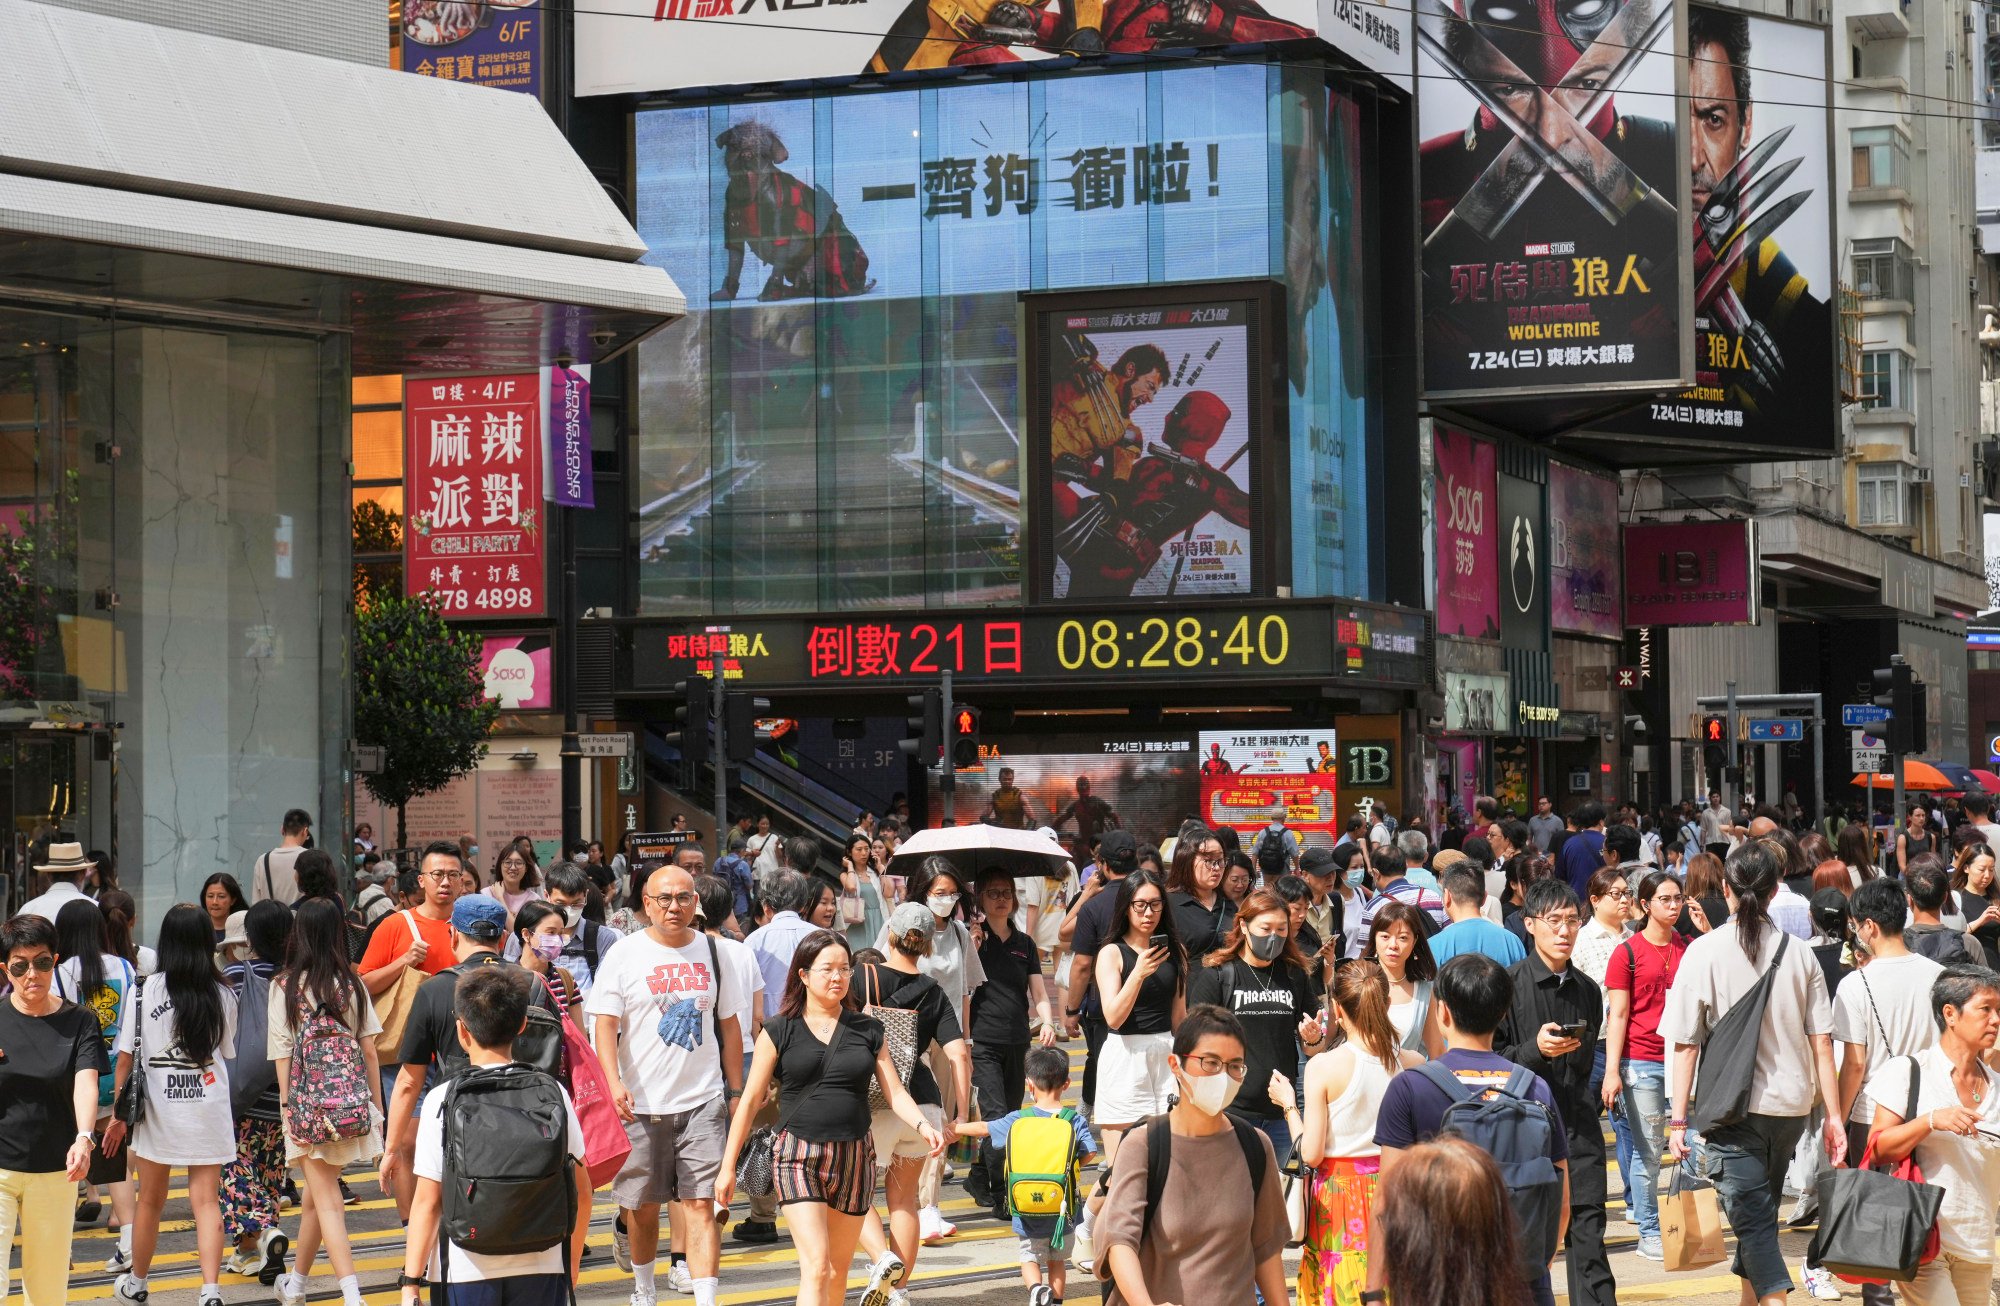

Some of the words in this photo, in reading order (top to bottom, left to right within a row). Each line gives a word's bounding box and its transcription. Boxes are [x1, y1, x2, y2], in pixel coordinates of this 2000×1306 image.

[499, 21, 532, 43] 6/F
[478, 62, 531, 77] 韓國料理
[1525, 244, 1549, 256] MARVEL
[1550, 241, 1575, 254] STUDIOS
[1450, 254, 1651, 304] 死侍與狼人
[1507, 303, 1597, 324] DEADPOOL
[1508, 321, 1601, 341] WOLVERINE
[1468, 348, 1542, 370] 7.24(三)
[1547, 344, 1635, 366] 爽爆大銀幕
[571, 380, 580, 437] HONG
[1651, 404, 1693, 424] 7.24(三)
[1695, 407, 1744, 427] 爽爆大銀幕
[429, 411, 524, 467] 麻辣
[565, 422, 573, 467] WORLD
[1321, 428, 1346, 459] Dolby
[572, 441, 581, 499] KONG
[566, 468, 574, 497] CITY
[429, 473, 524, 528] 派對
[431, 535, 470, 554] CHILI
[472, 535, 521, 553] PARTY
[1170, 539, 1243, 557] 死侍與狼人
[475, 587, 532, 610] 4898
[668, 633, 769, 658] 死侍與狼人
[1057, 615, 1289, 670] 08:28:40
[1640, 644, 1650, 678] WALK
[1527, 705, 1535, 720] THE
[1536, 706, 1547, 720] BODY
[1548, 707, 1559, 721] SHOP
[590, 745, 613, 753] 東角道
[1103, 742, 1142, 753] 7.24(三)
[1145, 740, 1190, 752] 爽爆大銀幕
[1869, 751, 1880, 759] hr
[874, 750, 894, 767] 3F
[646, 962, 711, 981] STAR
[646, 977, 711, 995] WARS
[1233, 989, 1295, 1010] THRASHER
[167, 1074, 203, 1088] DUNK
